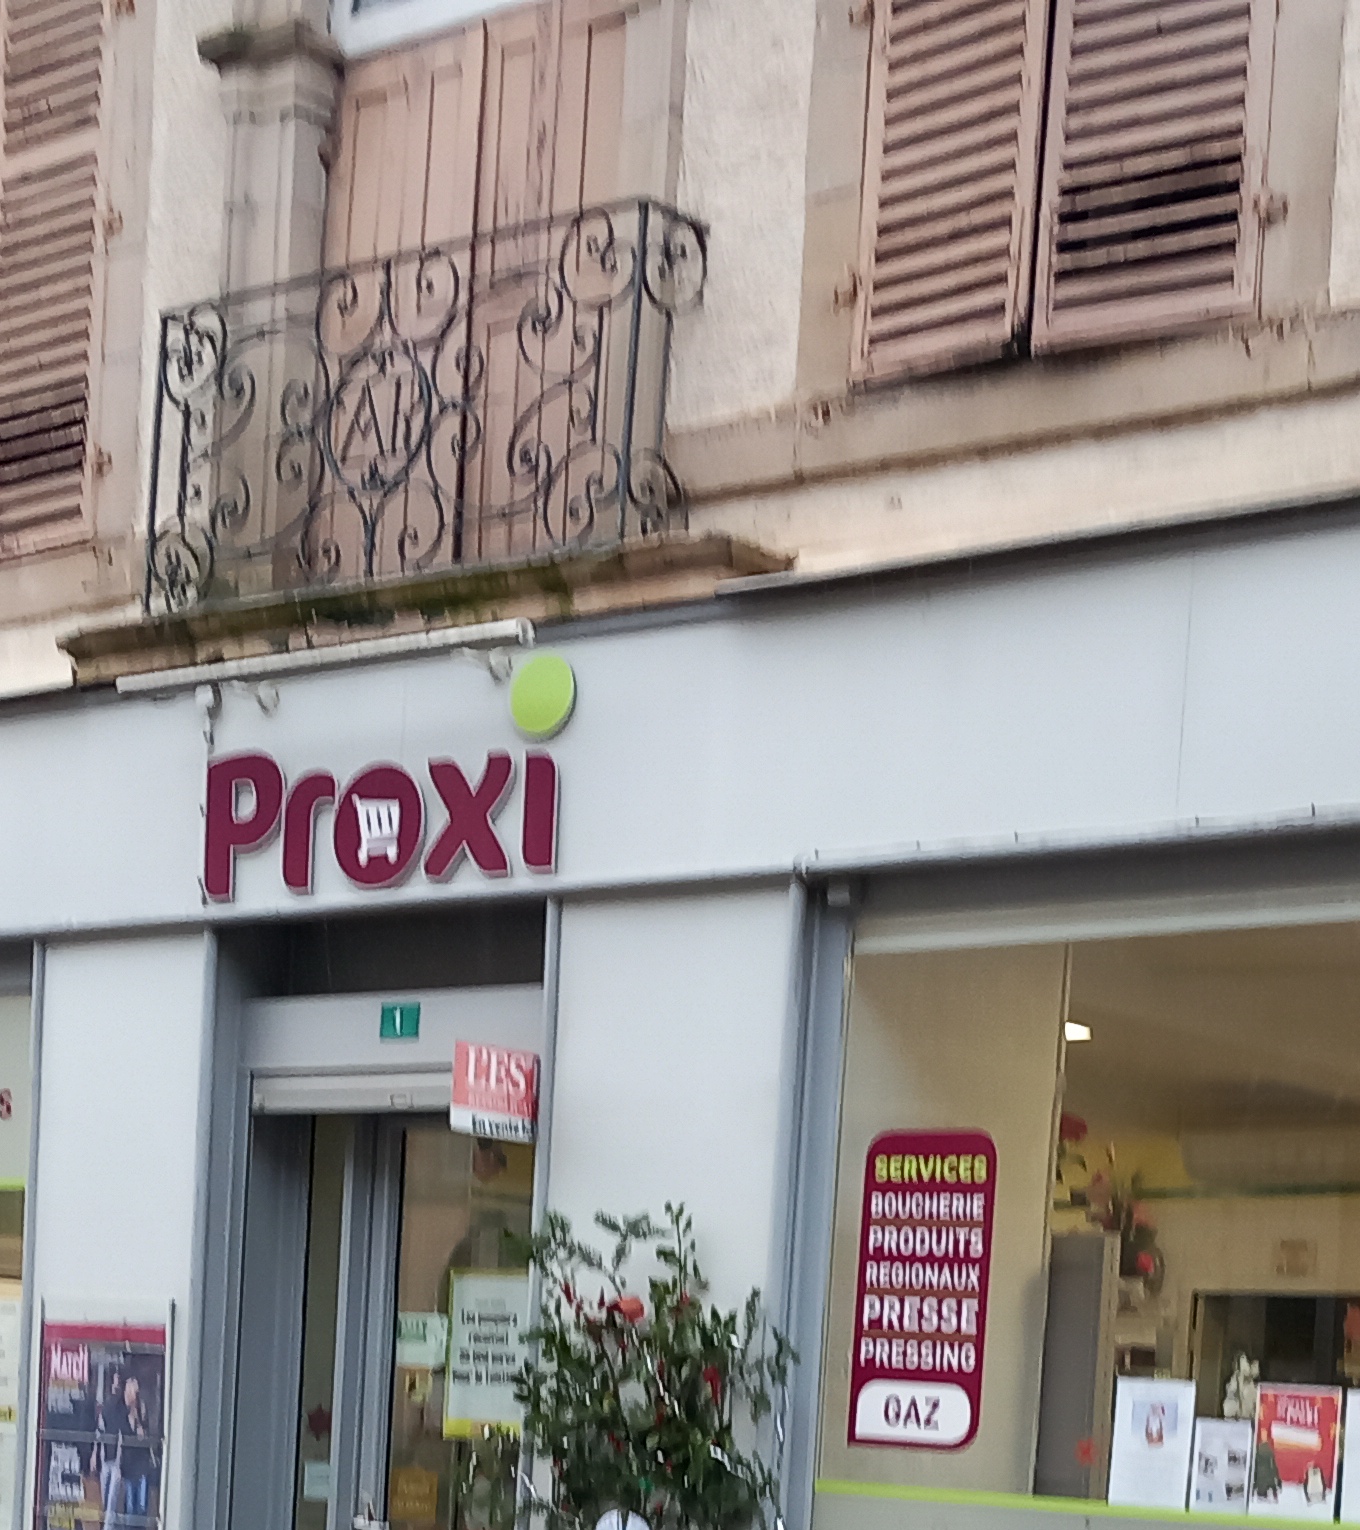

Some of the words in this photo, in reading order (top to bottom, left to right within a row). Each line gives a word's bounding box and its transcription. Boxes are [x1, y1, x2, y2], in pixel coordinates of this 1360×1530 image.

[203, 650, 576, 902] Proxi
[875, 1153, 988, 1184] SERVICES
[870, 1190, 986, 1221] BOUCHERIE
[868, 1225, 984, 1258] PRODUITS
[862, 1293, 980, 1336] PRESSE
[859, 1336, 976, 1374] PRESSING
